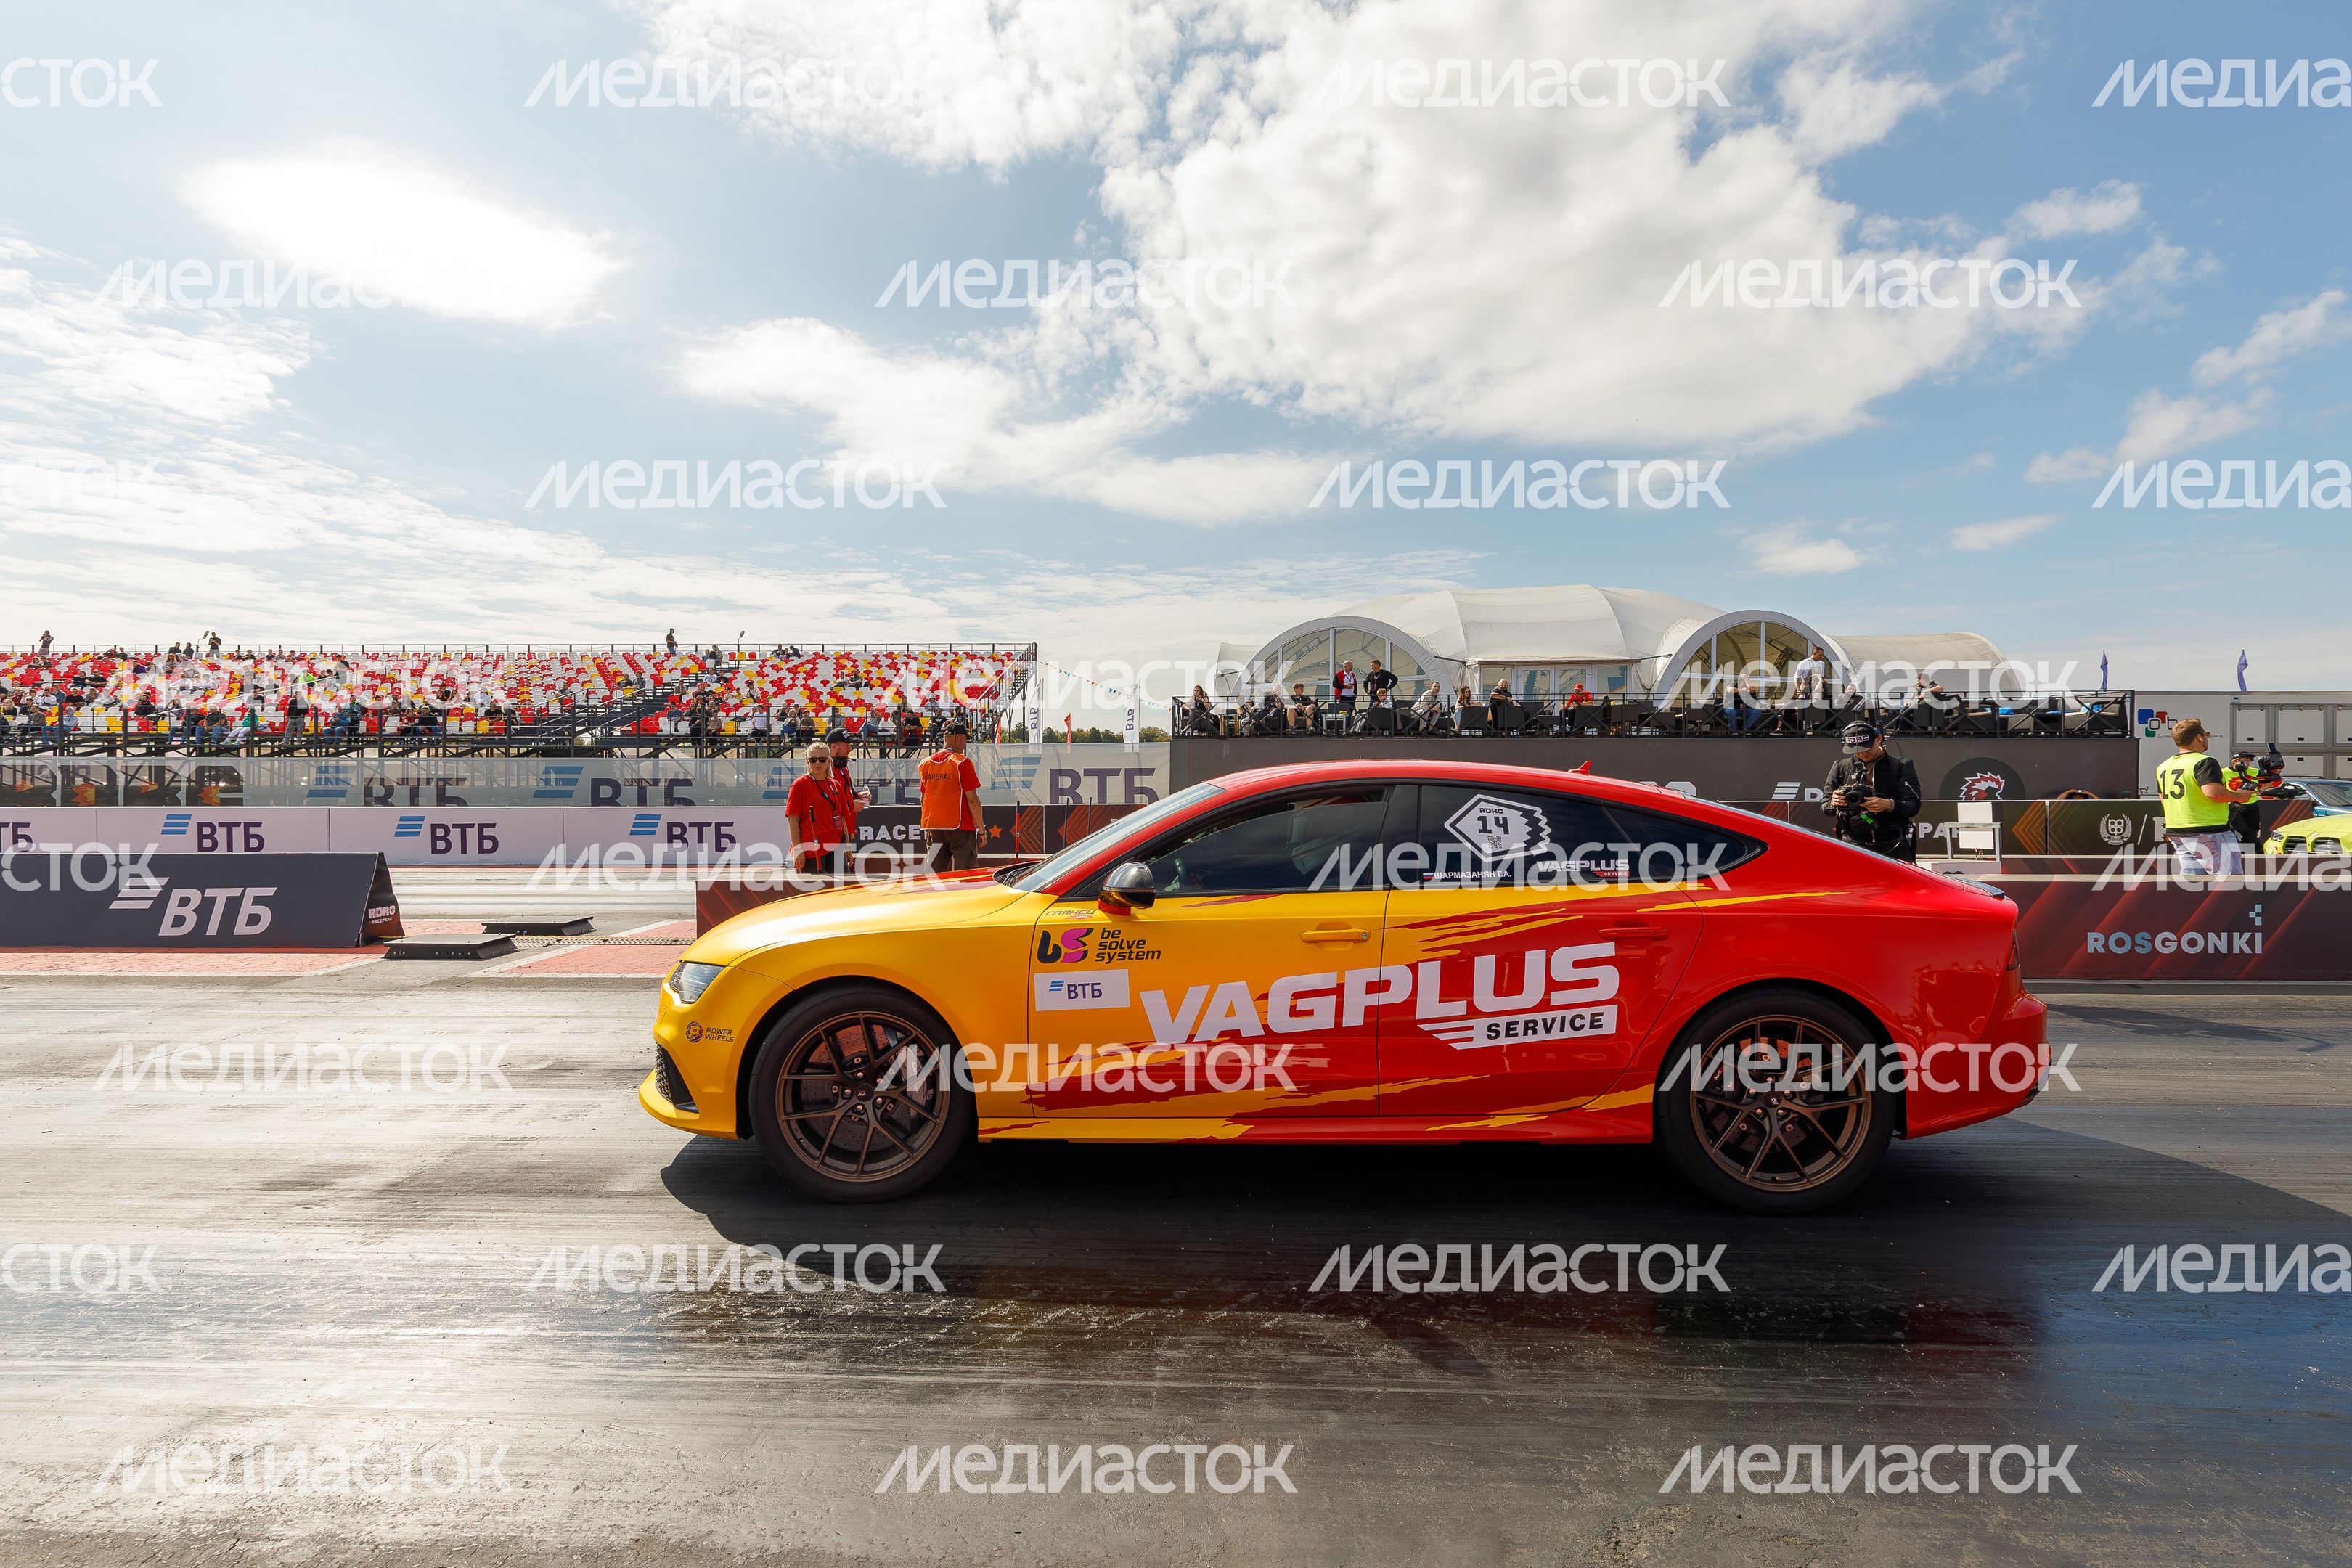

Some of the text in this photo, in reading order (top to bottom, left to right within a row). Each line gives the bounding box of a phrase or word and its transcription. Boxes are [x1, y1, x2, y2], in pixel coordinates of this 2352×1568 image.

[1049, 767, 1159, 804] ВТБ
[2160, 769, 2185, 799] 13
[1477, 816, 1509, 835] 14
[197, 822, 265, 853] ВТБ
[430, 823, 499, 854] ВТБ
[666, 822, 737, 853] ВТБ
[1537, 859, 1630, 872] VAGPLUS
[158, 887, 277, 936] ВТБ
[1101, 928, 1122, 939] be
[2087, 932, 2262, 954] ROSGONKI
[1098, 939, 1147, 951] solve
[1095, 950, 1162, 965] system
[1067, 982, 1103, 1000] ВТБ
[1139, 942, 1620, 1045] VAGPLUS
[706, 1027, 732, 1036] POWER
[1486, 1012, 1604, 1040] SERVICE
[705, 1033, 735, 1043] WHEELS
